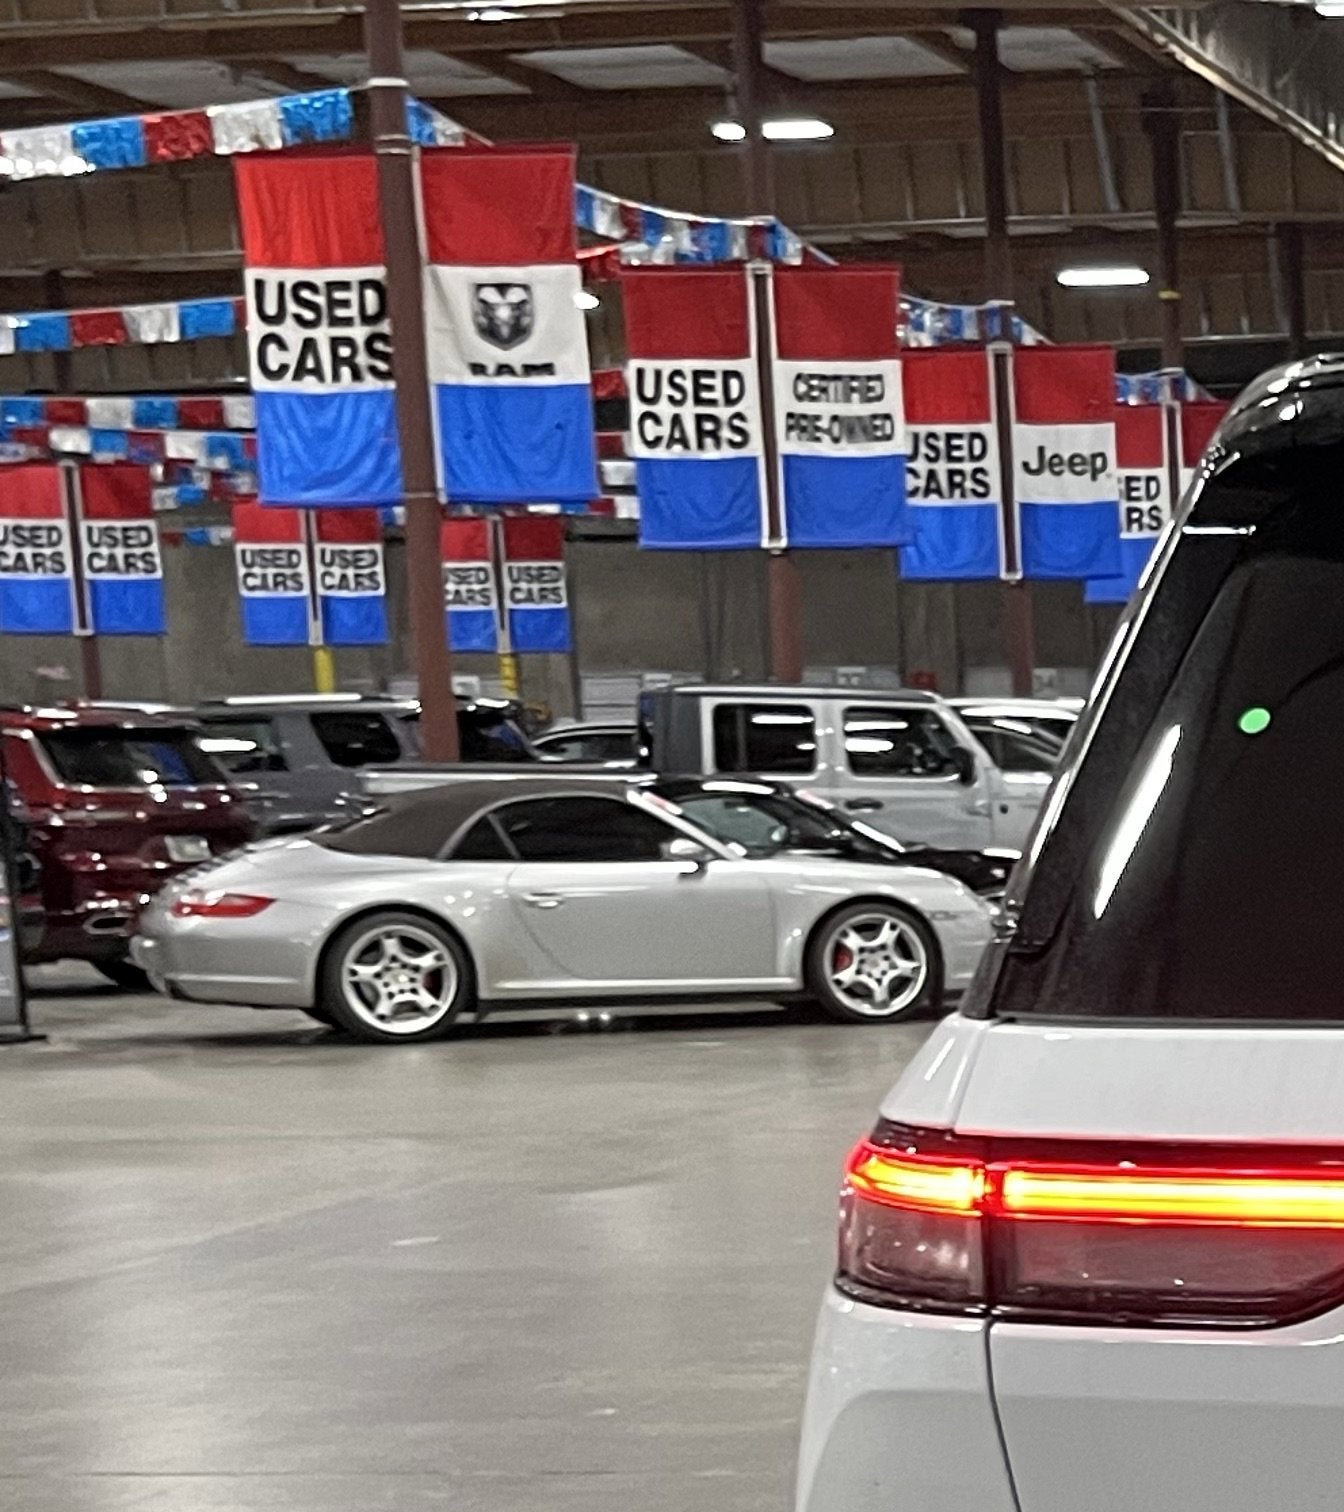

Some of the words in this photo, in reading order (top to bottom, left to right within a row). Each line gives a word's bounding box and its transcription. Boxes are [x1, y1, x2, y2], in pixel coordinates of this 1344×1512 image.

[254, 278, 388, 328] USED
[257, 332, 394, 383] CARS
[467, 361, 556, 377] RAM
[636, 366, 746, 407] USED
[637, 409, 750, 451] CARS
[1021, 445, 1107, 482] Jeep
[86, 525, 154, 548] USED
[87, 551, 158, 574] CARS
[240, 549, 303, 569] USED
[320, 548, 379, 569] USED
[243, 571, 305, 592] CARS
[321, 571, 382, 592] CARS
[508, 565, 562, 583] USED
[510, 586, 565, 605] CARS
